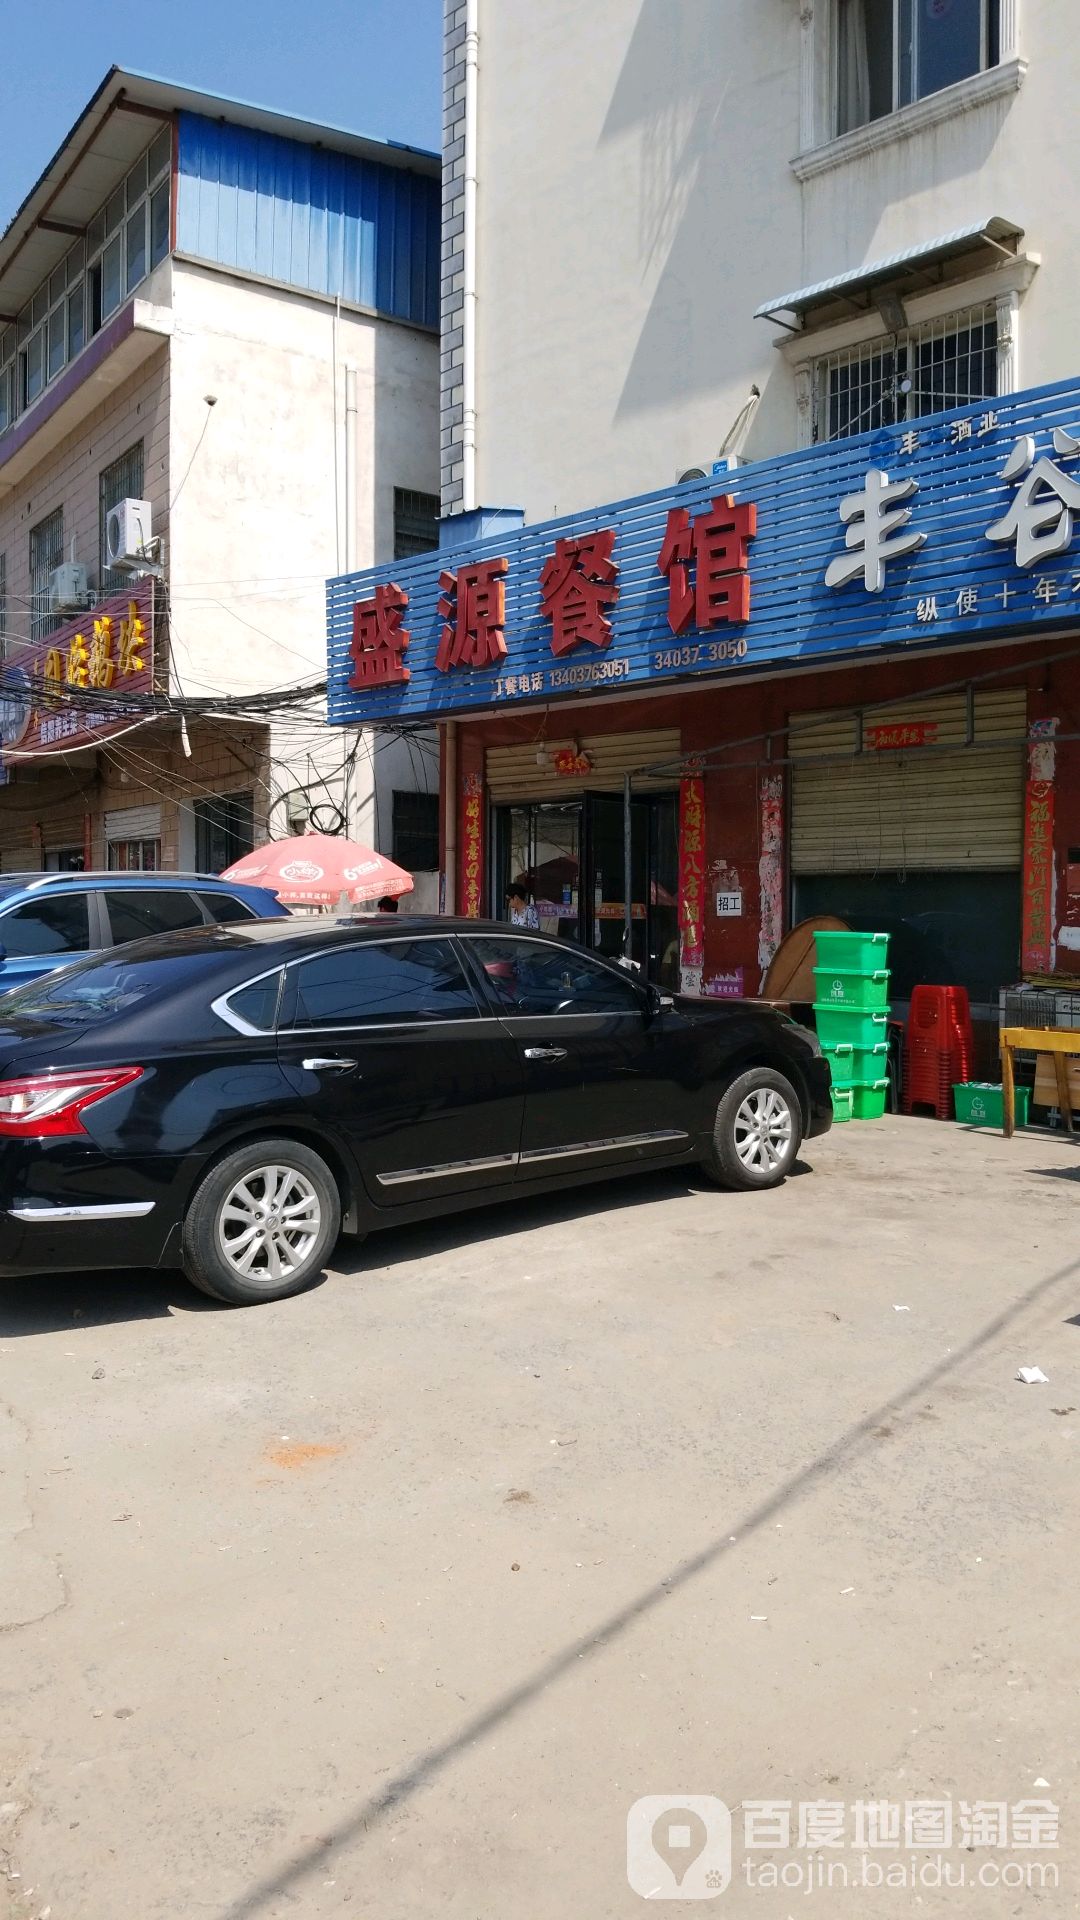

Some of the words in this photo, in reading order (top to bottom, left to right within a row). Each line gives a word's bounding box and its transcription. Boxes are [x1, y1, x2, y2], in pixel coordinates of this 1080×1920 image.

[824, 427, 1080, 593] 丰谷
[348, 494, 757, 689] 盛源餐馆
[550, 659, 629, 687] 13403763051
[718, 897, 741, 912] 招工
